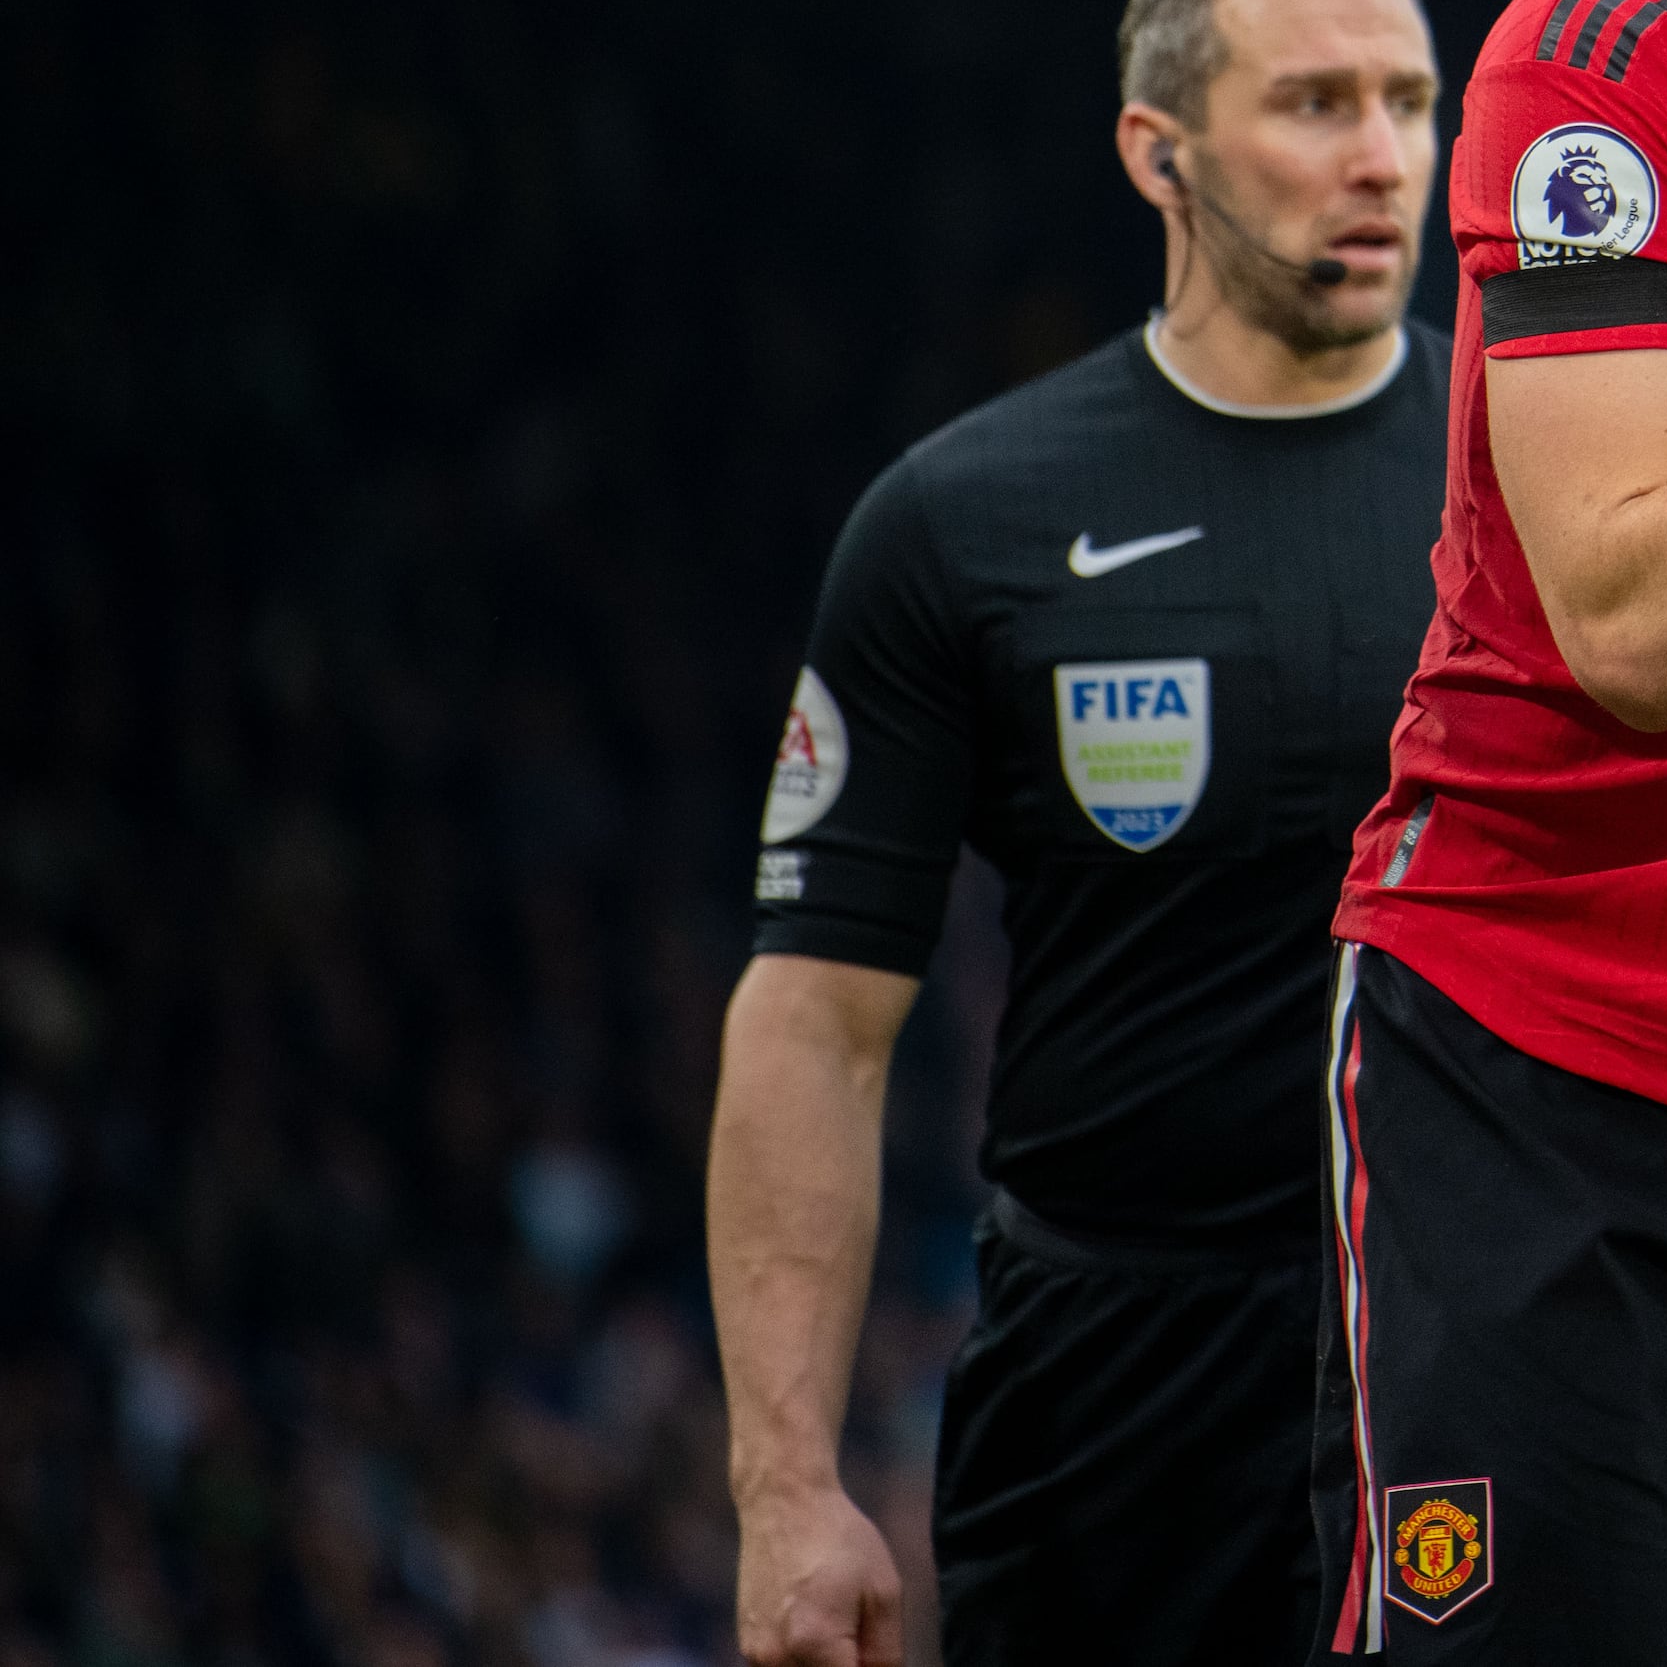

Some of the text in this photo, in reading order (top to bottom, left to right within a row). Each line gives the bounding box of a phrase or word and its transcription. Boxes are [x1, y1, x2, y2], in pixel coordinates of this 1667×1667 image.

[1615, 197, 1640, 241] League
[1071, 678, 1190, 721] FIFA
[1087, 762, 1184, 781] REFEREE
[1402, 1505, 1472, 1541] MANCHESTER
[1413, 1573, 1462, 1592] UNITED
